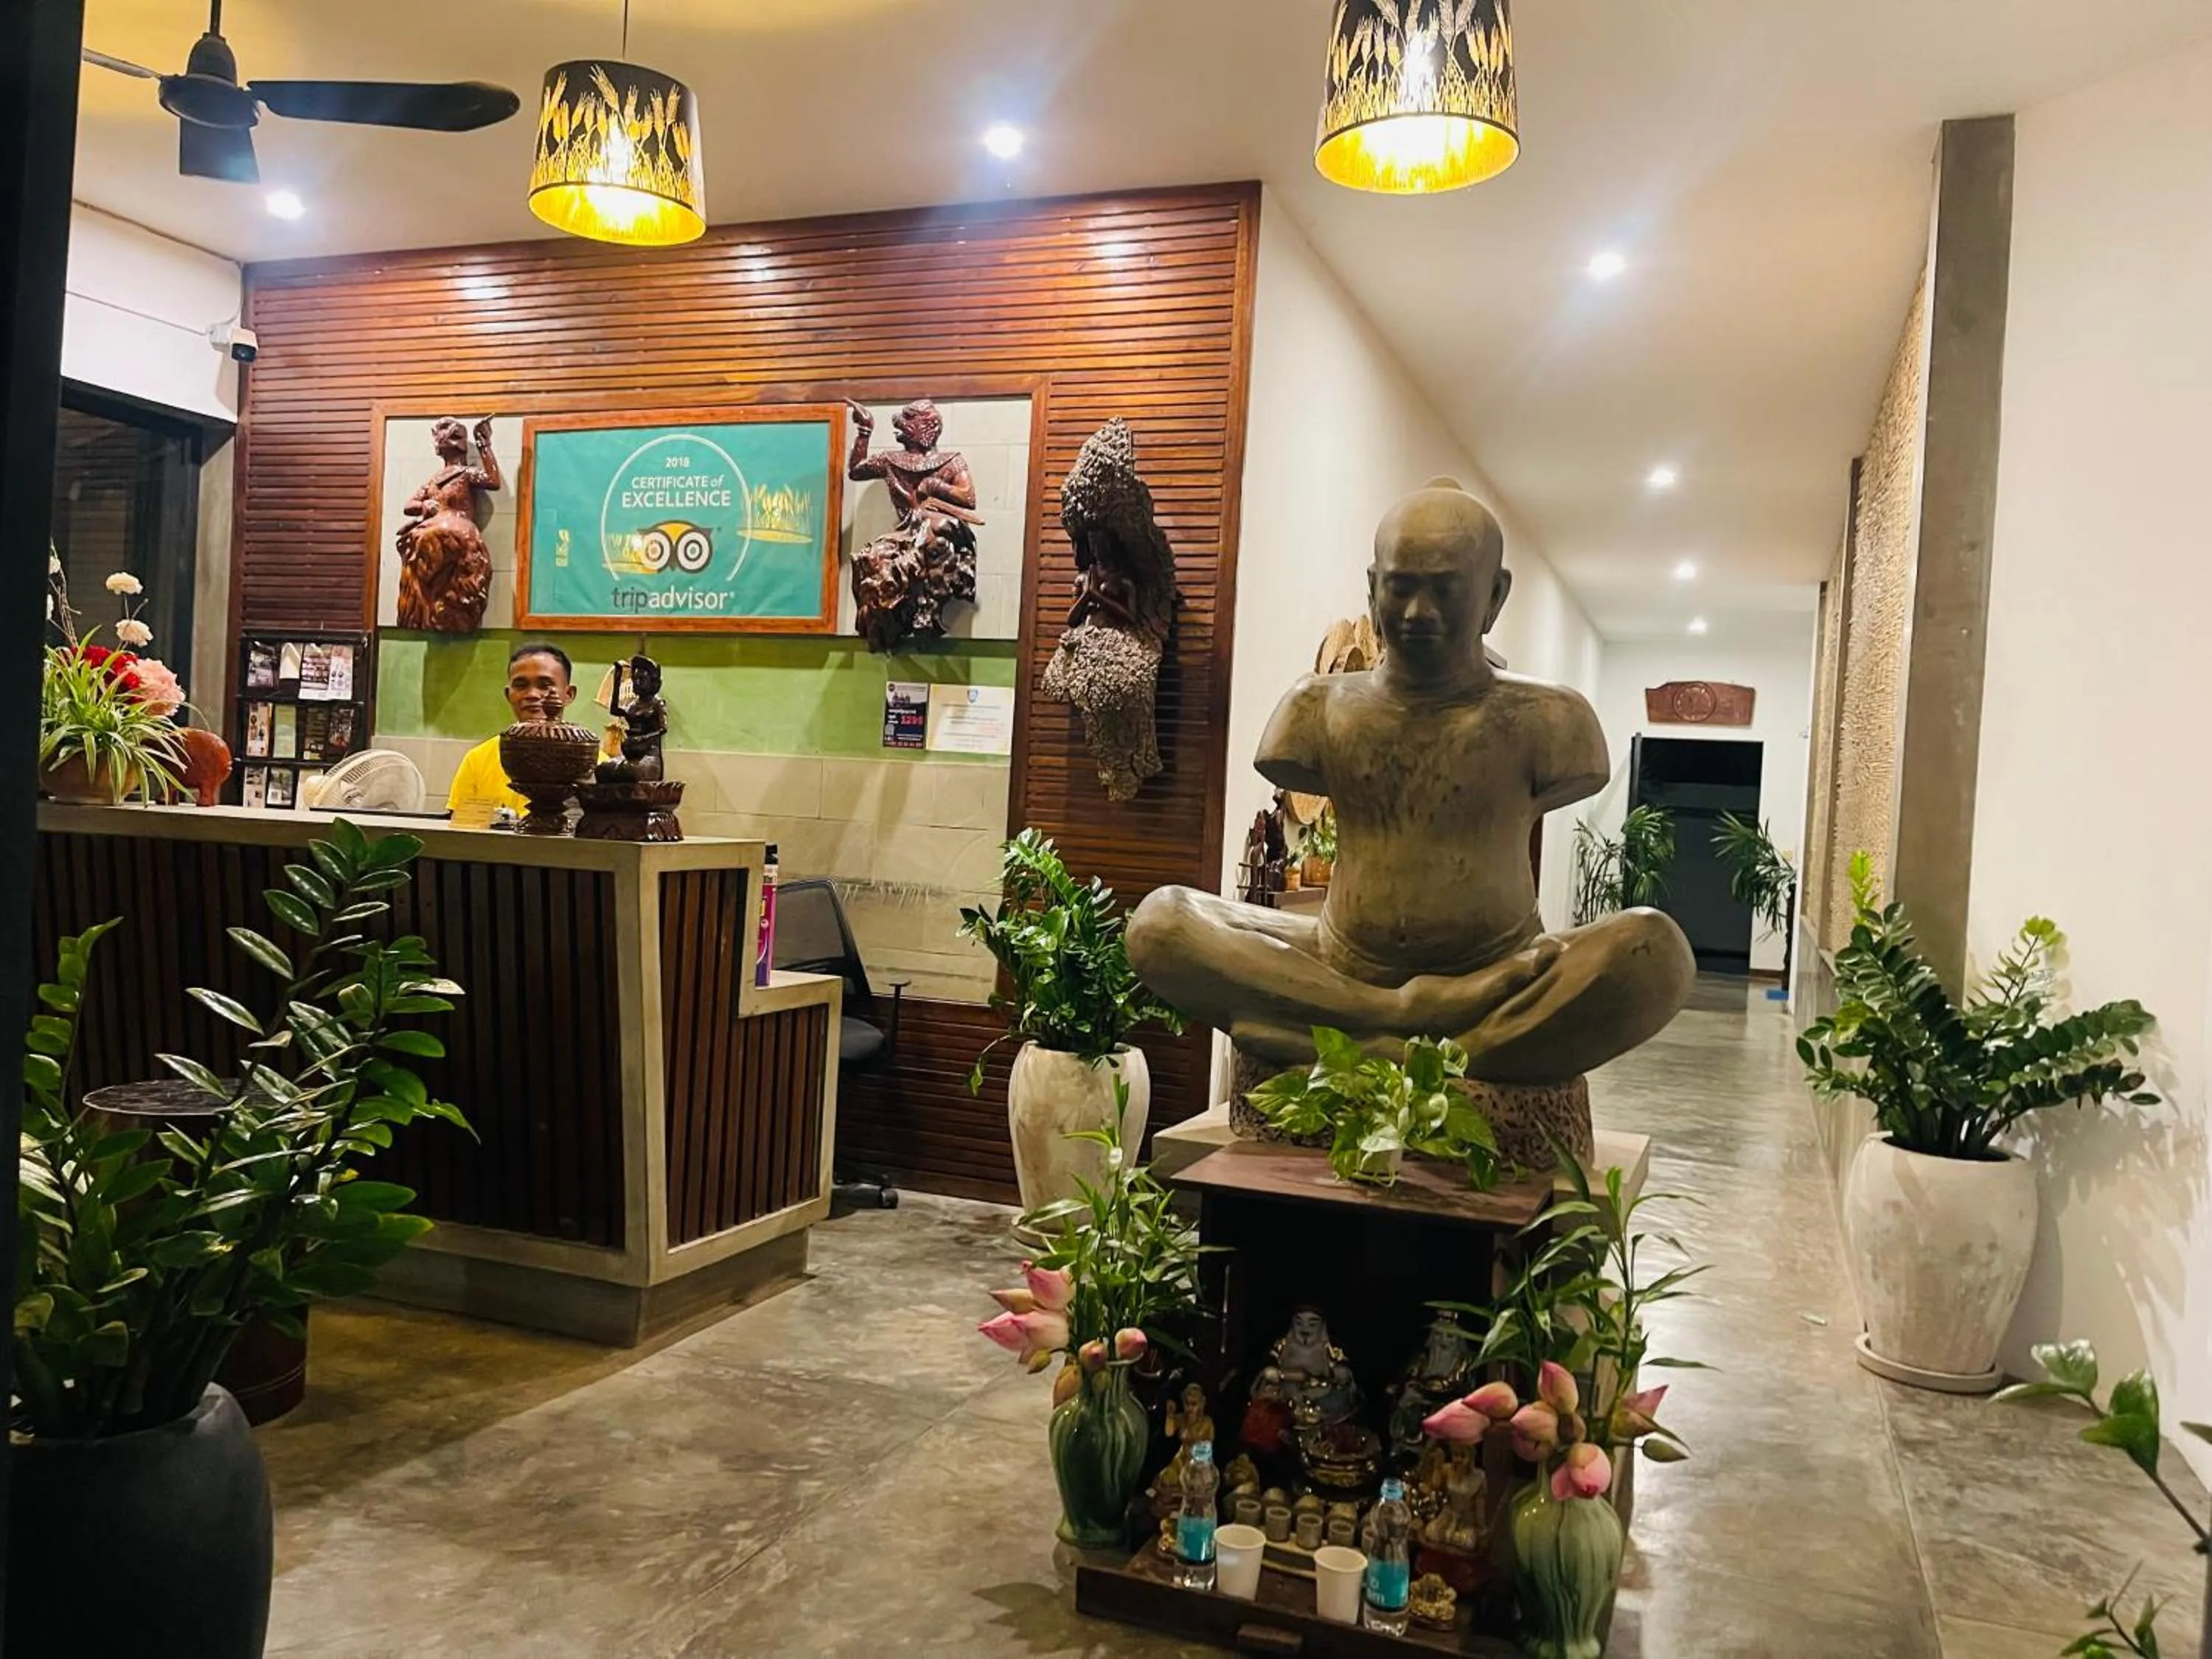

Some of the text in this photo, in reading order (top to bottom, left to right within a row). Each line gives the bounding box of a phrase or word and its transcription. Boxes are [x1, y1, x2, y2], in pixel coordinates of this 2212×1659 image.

[665, 456, 690, 468] 2018
[631, 474, 726, 490] CERTIFICATE of
[622, 490, 731, 508] EXCELLENCE
[611, 585, 728, 613] tripadvisor
